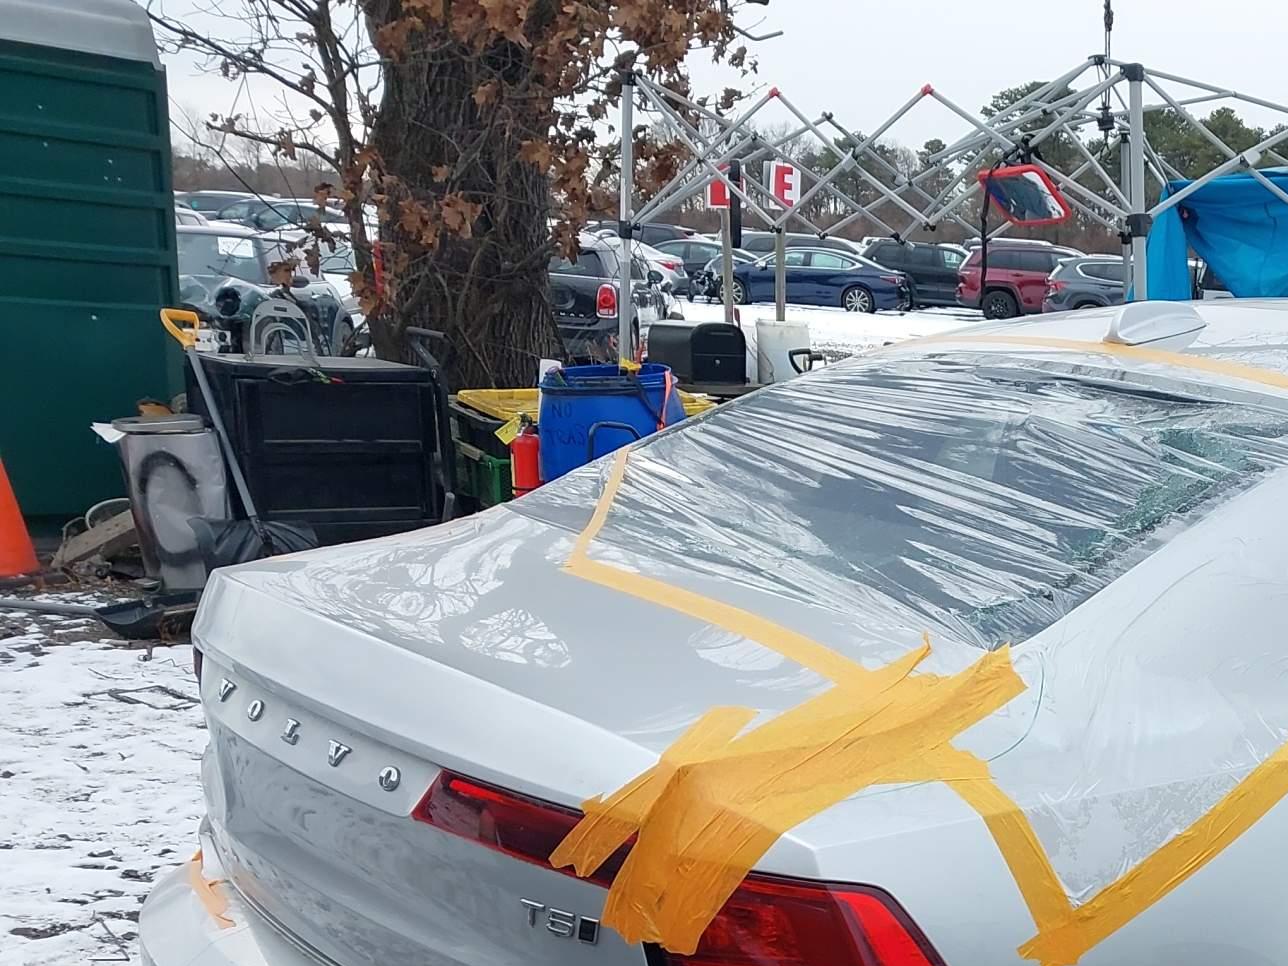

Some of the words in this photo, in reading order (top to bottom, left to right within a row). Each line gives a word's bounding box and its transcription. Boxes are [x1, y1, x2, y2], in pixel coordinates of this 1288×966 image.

[551, 401, 572, 418] NO
[544, 424, 587, 446] TRAS
[218, 678, 401, 792] VOLVO
[520, 897, 576, 938] T5
